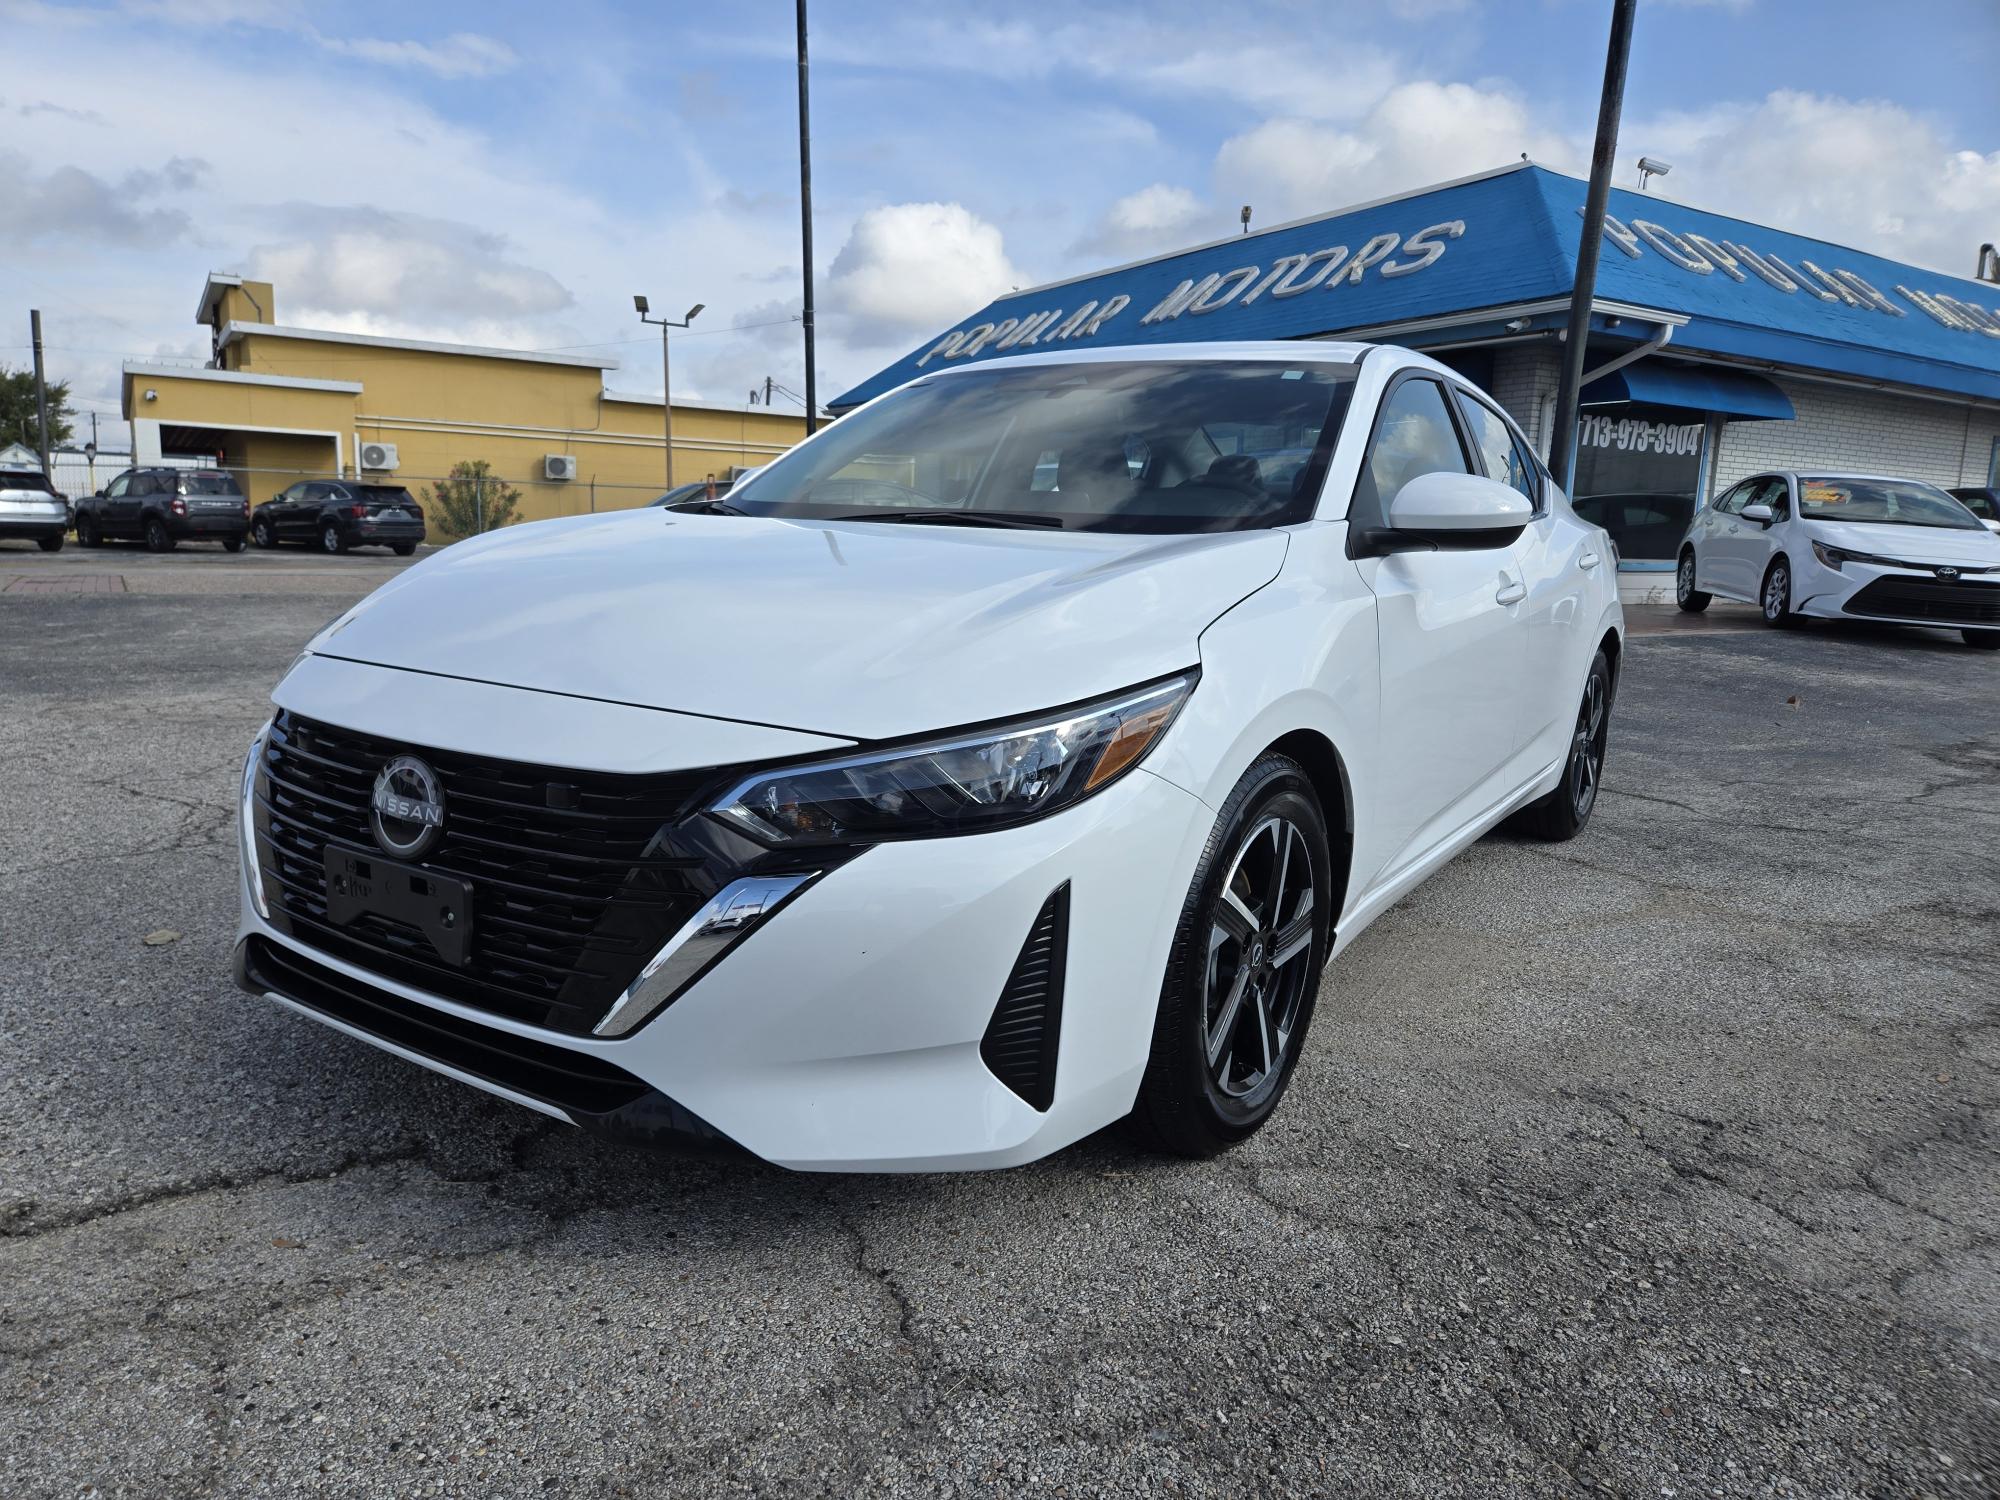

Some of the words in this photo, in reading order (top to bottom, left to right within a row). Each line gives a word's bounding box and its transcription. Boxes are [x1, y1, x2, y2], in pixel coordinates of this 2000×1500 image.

[916, 294, 1130, 367] POPULAR
[1140, 220, 1466, 325] MOTORS
[1581, 415, 1699, 456] 713-973-3904
[375, 791, 439, 823] NISSAN
